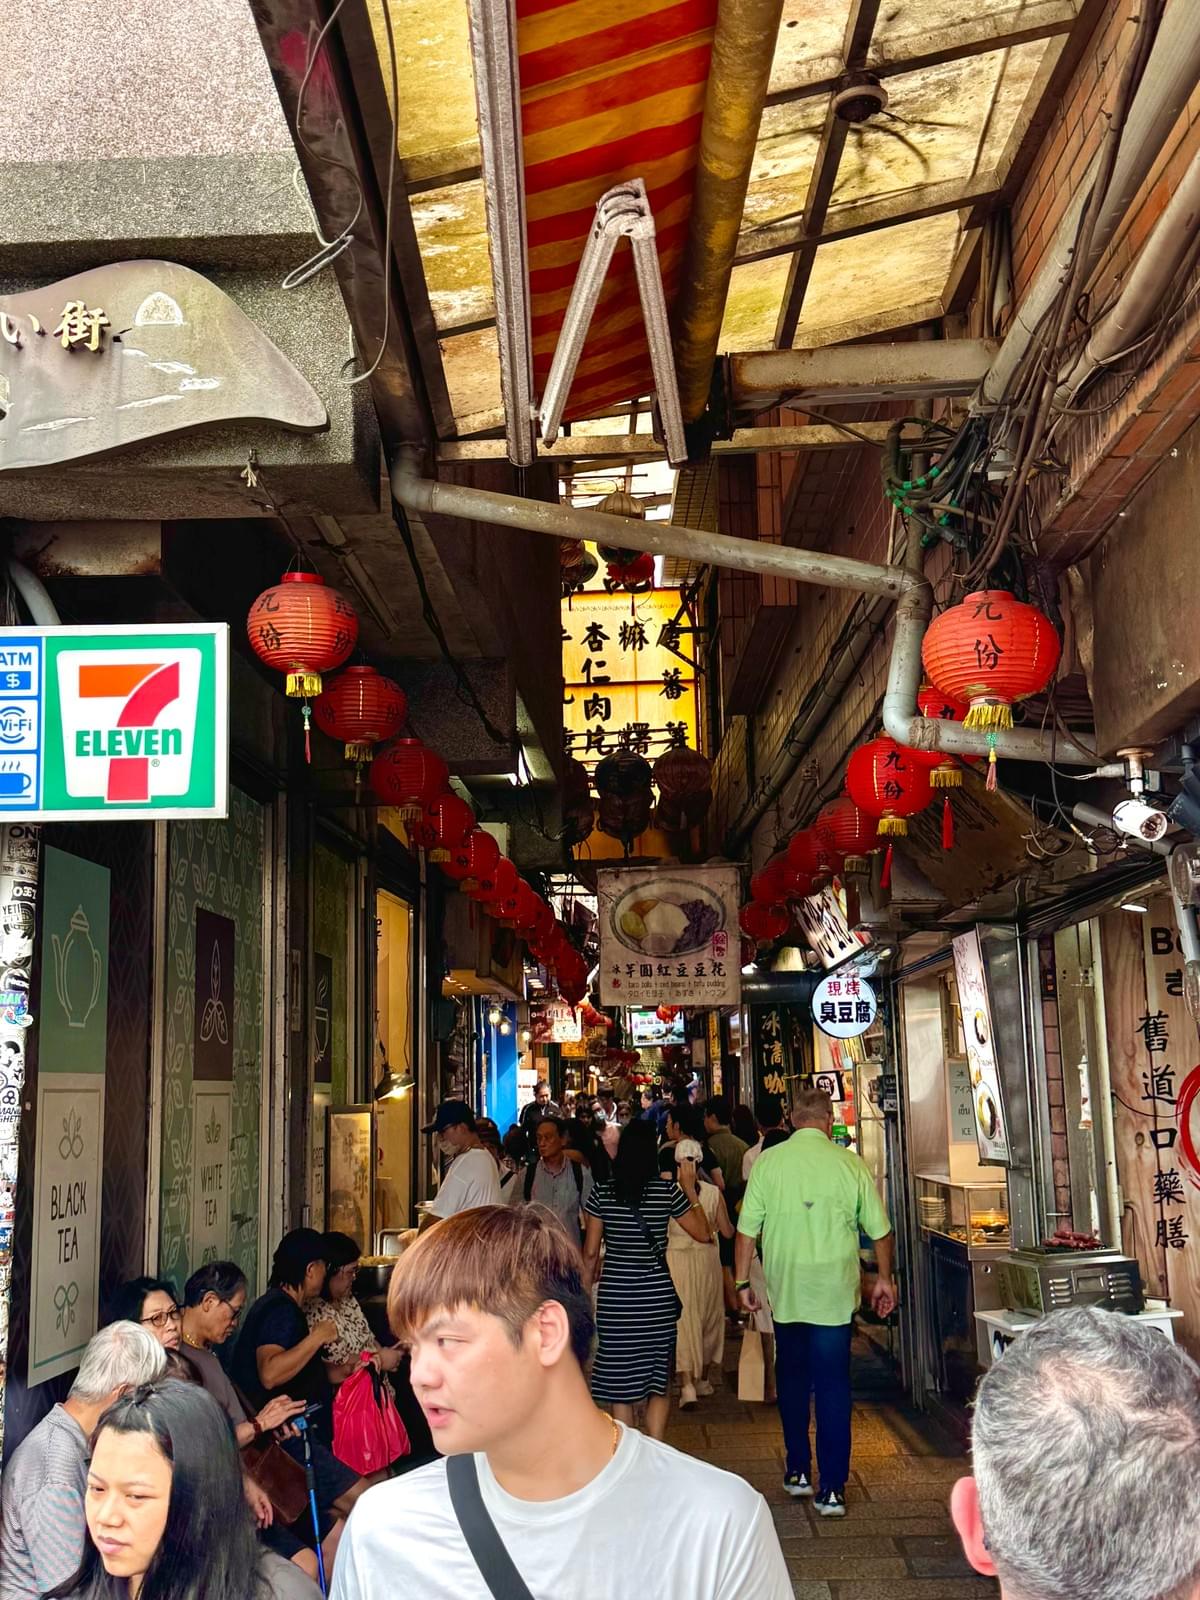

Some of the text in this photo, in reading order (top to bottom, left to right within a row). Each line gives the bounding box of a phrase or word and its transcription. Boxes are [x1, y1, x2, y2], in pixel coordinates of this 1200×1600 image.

[256, 592, 284, 651] 九份
[972, 601, 1004, 671] 九份
[0, 652, 32, 666] ATM
[883, 751, 907, 799] 九份
[625, 961, 727, 978] 芋圓紅豆豆花
[820, 1001, 871, 1024] 臭豆腐
[961, 1127, 973, 1136] ICE
[1136, 1009, 1189, 1249] 舊道口藥膳
[200, 1164, 223, 1192] WHITE
[51, 1180, 87, 1221] BLACK
[205, 1199, 218, 1227] TEA
[58, 1226, 79, 1265] TEA
